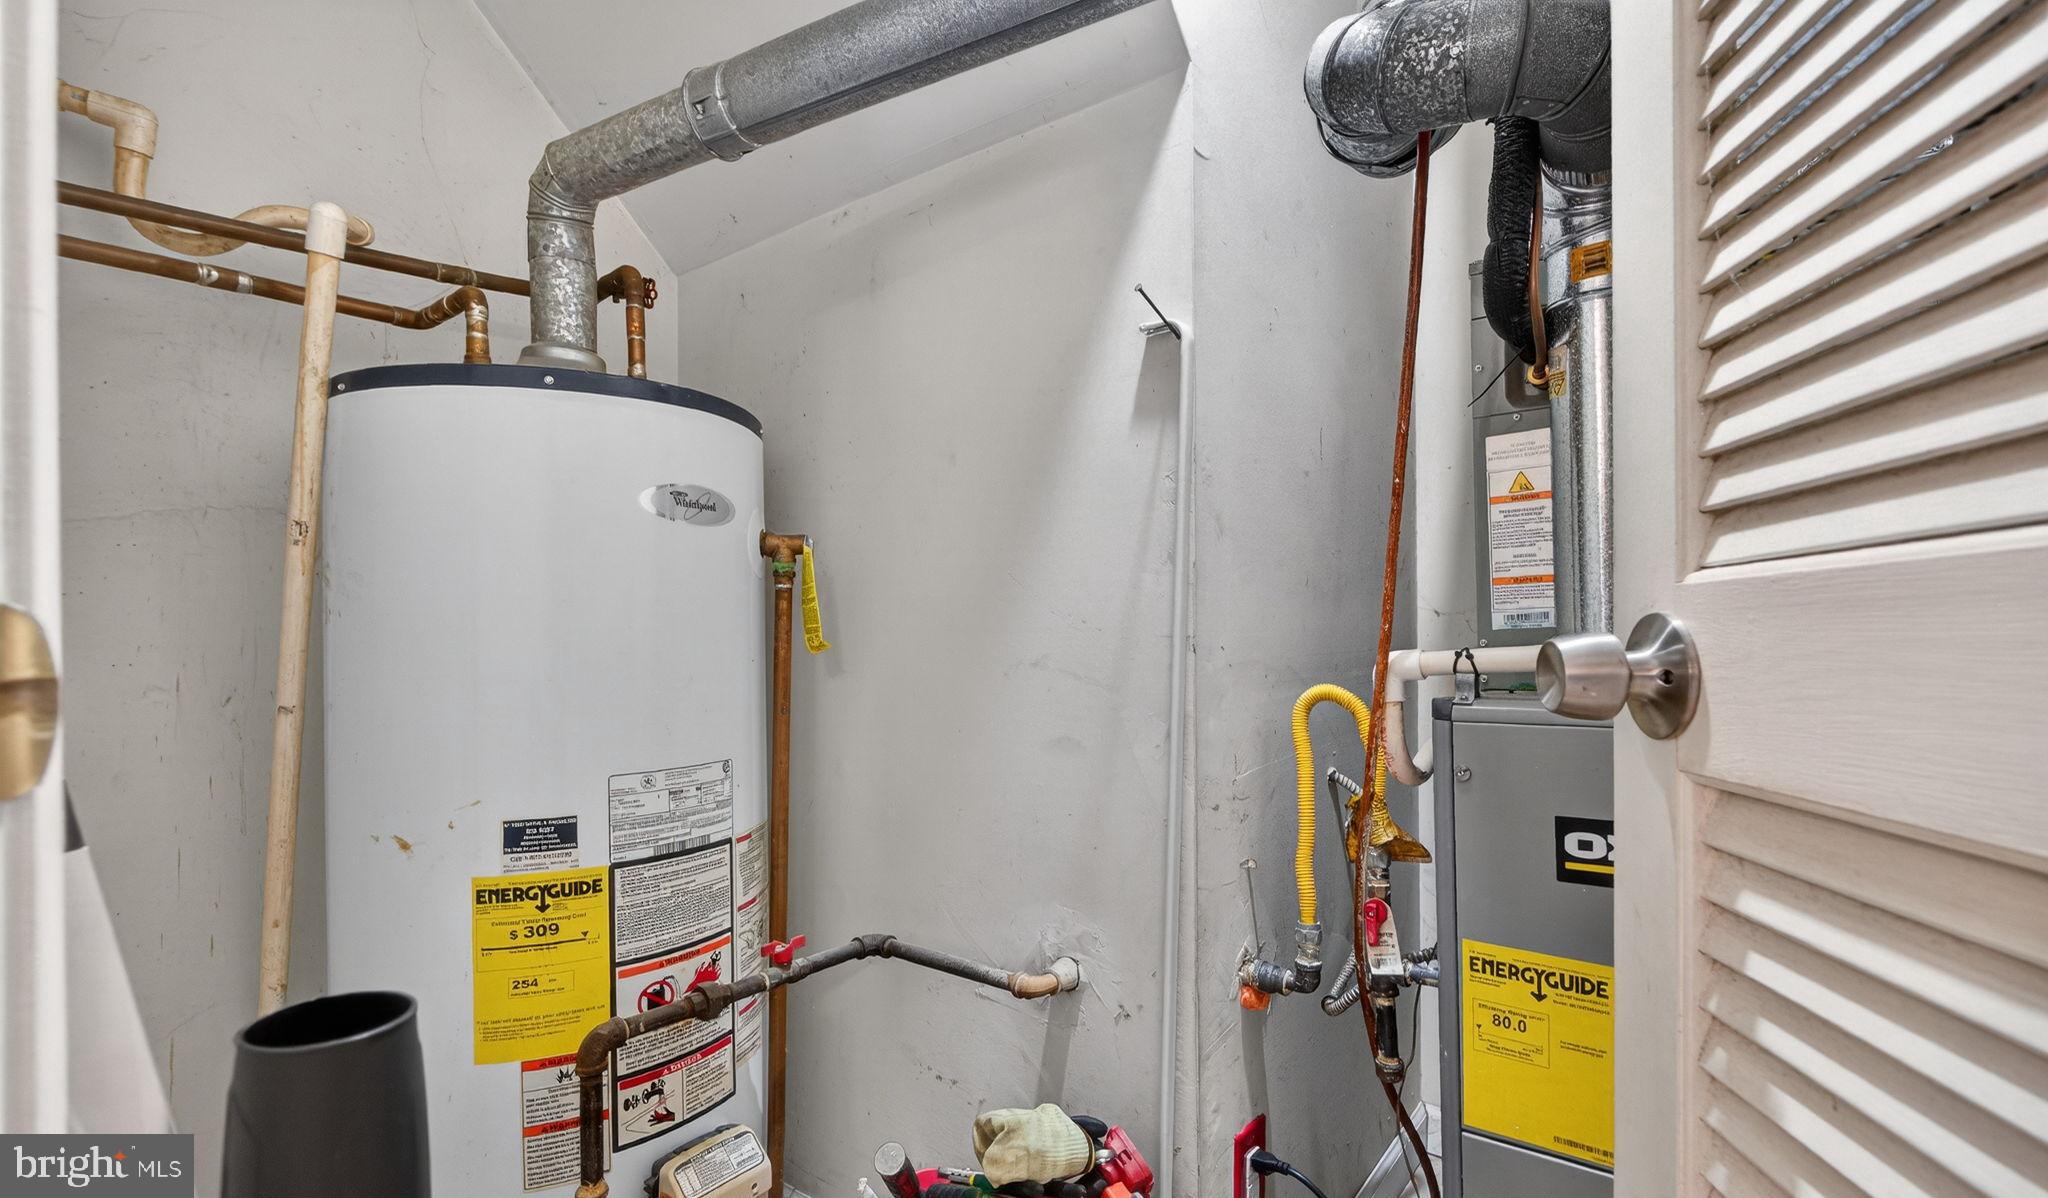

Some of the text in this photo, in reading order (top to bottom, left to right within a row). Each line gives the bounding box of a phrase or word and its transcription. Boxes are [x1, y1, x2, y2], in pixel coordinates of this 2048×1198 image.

[475, 878, 603, 912] ENERGYGUIDE
[523, 922, 560, 939] 309
[512, 977, 539, 991] 254
[1469, 956, 1610, 1001] ENERGYGUIDE
[1491, 1013, 1528, 1034] 80.0
